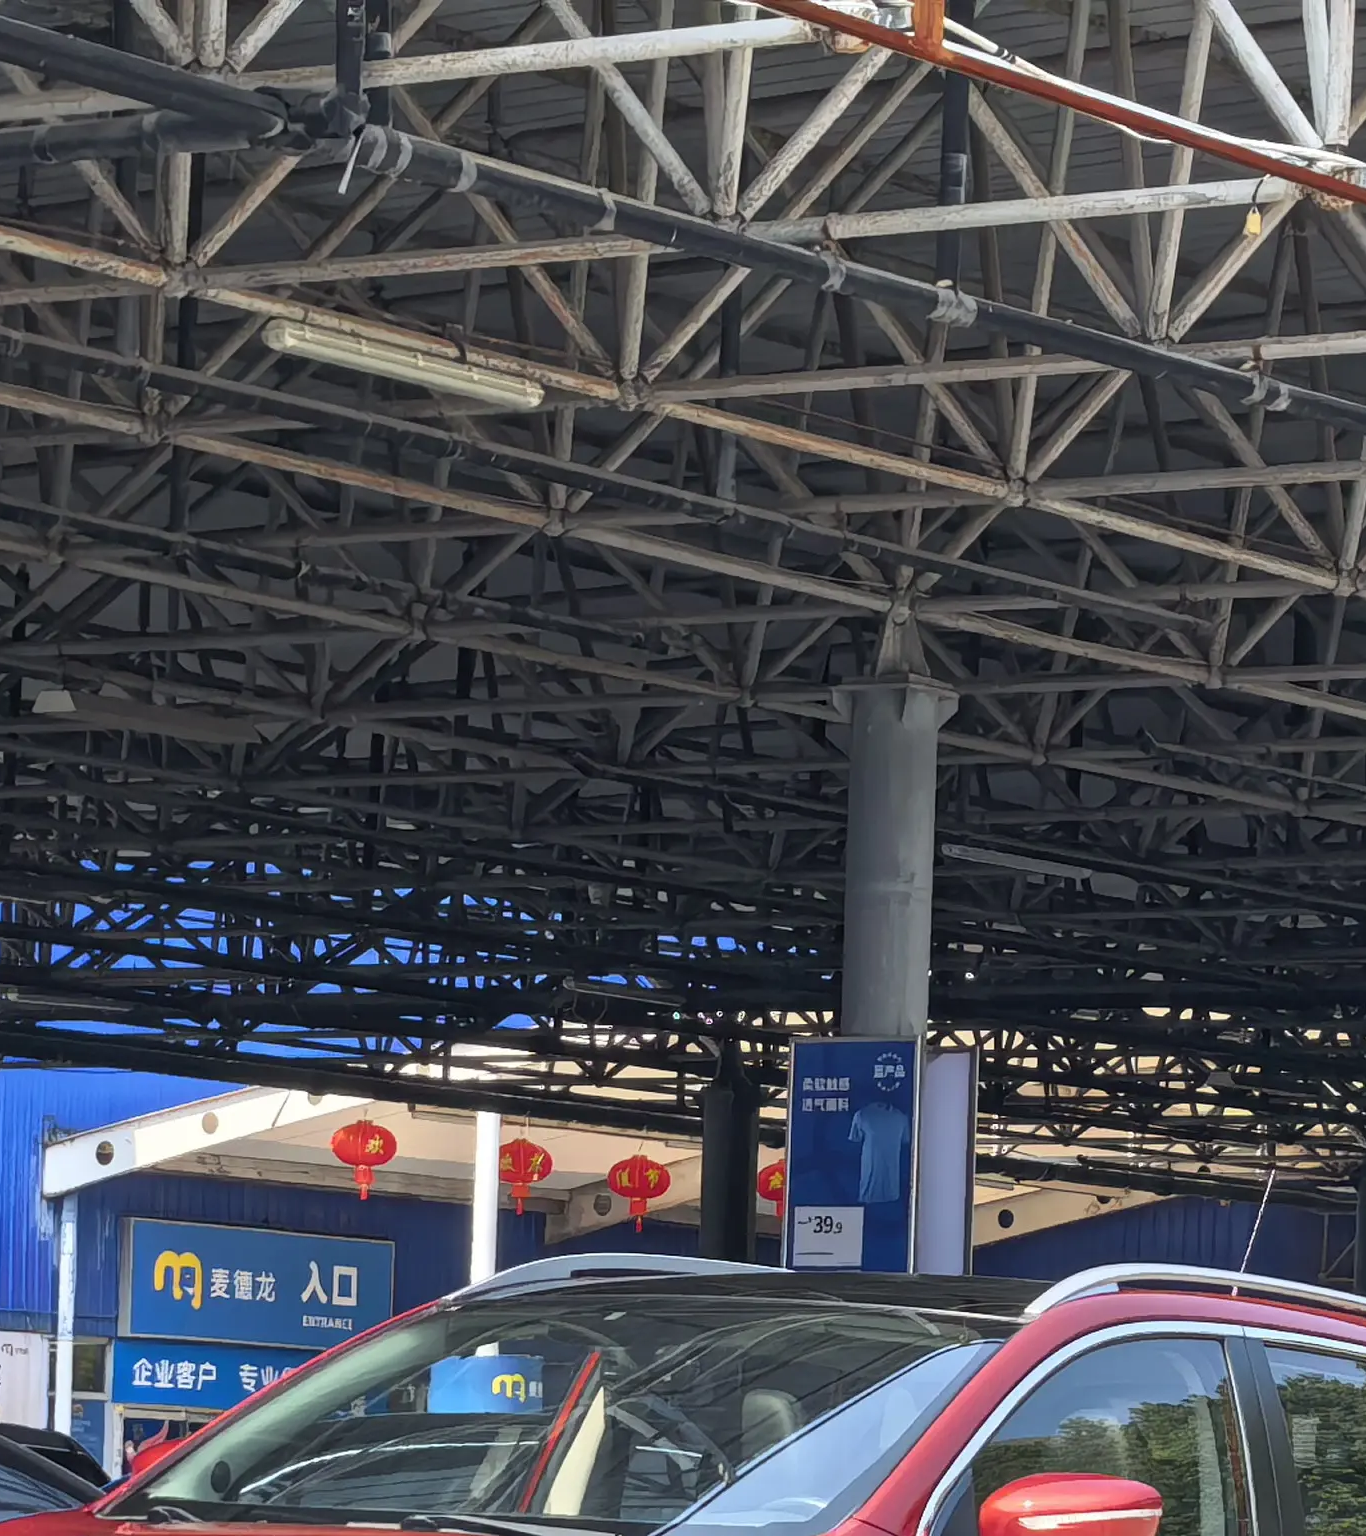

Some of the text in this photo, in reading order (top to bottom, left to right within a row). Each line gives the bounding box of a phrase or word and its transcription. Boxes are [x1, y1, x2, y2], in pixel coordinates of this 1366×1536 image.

[210, 1260, 358, 1307] 麦德龙 入口
[131, 1357, 293, 1392] 企业客户 专业
